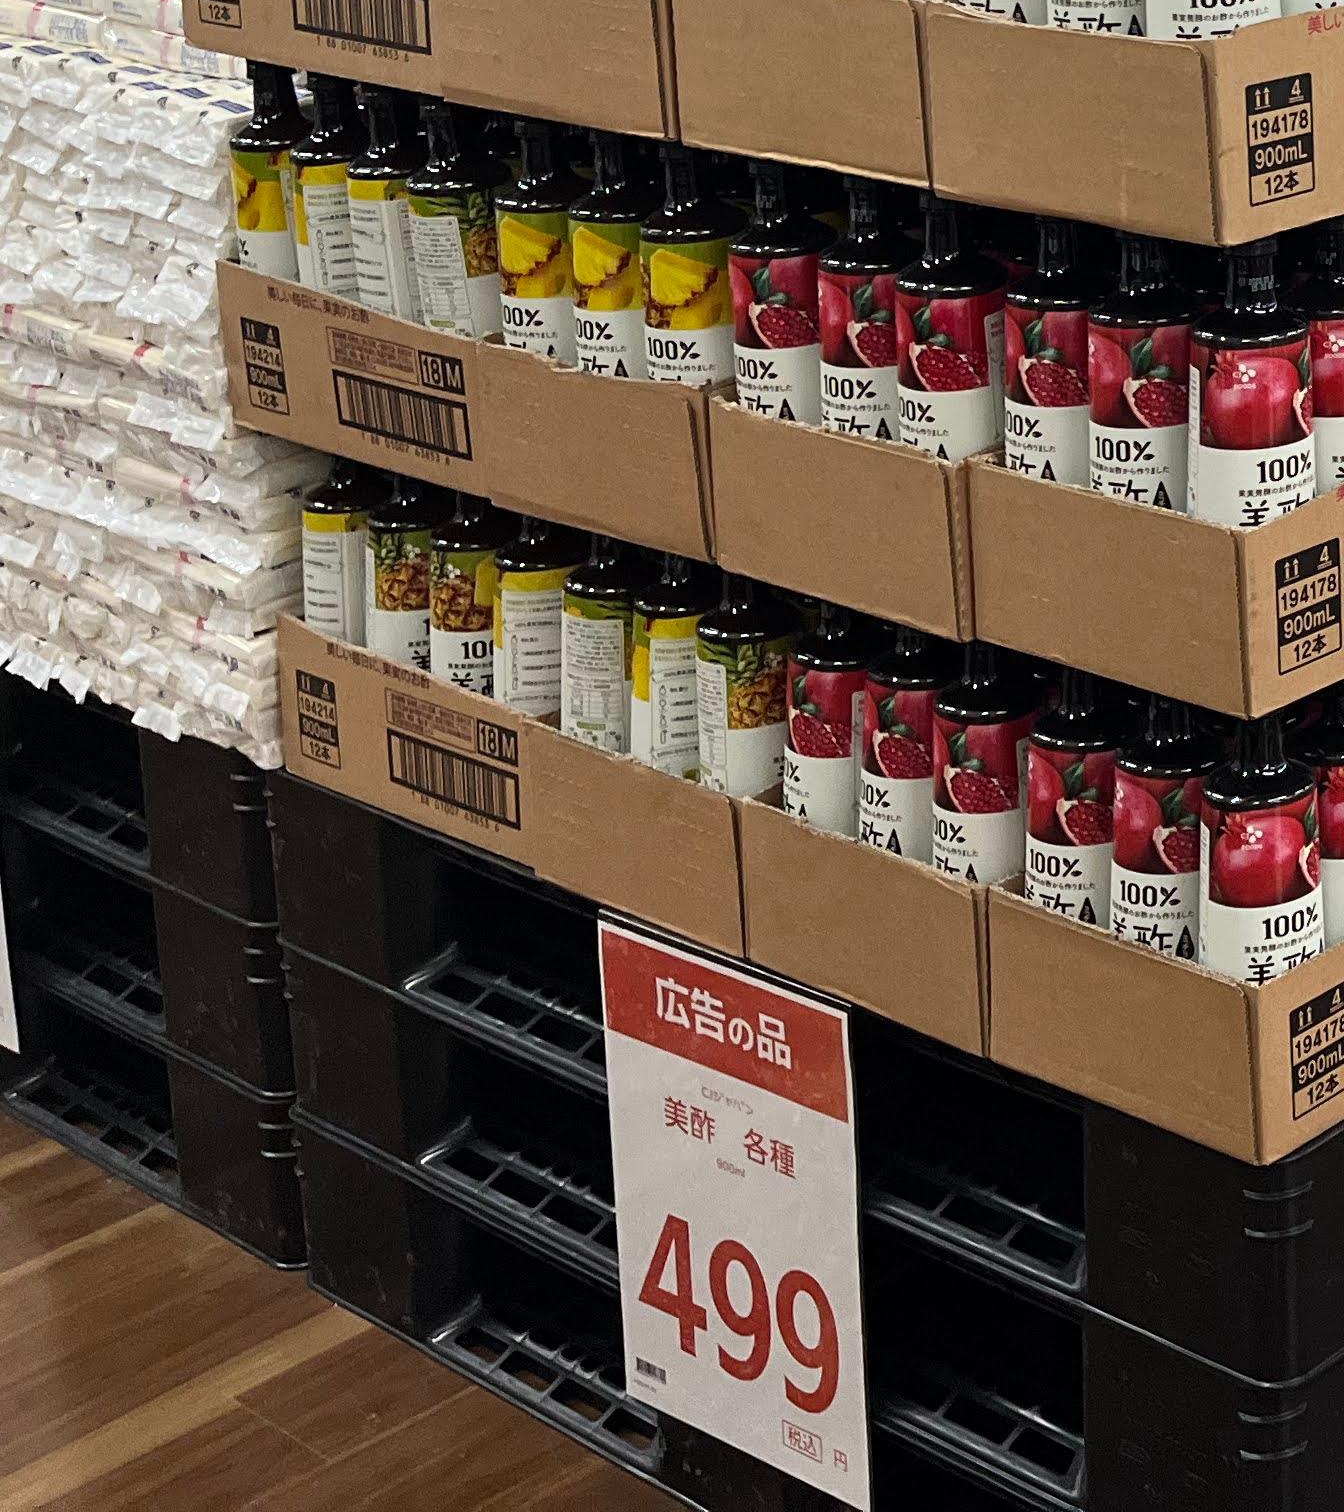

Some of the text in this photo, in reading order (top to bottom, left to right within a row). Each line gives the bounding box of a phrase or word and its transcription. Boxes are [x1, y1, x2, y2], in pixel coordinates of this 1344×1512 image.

[209, 4, 230, 20] 12本
[1251, 110, 1309, 139] 194178
[1255, 141, 1308, 169] 900mL
[1265, 171, 1299, 196] 12本
[1094, 438, 1155, 463] 100%
[1256, 454, 1311, 482] 100%
[1281, 575, 1337, 612] 194178
[1284, 610, 1335, 638] 900mL
[1294, 634, 1326, 663] 12本
[1030, 849, 1082, 877] 100%
[1121, 880, 1180, 907] 100%
[1263, 904, 1318, 940] 100%
[656, 977, 792, 1069] 広告の品
[1307, 1072, 1339, 1105] 12本
[665, 1097, 796, 1181] 美酢 各種
[639, 1215, 840, 1415] 499
[786, 1426, 848, 1472] 税込 円
